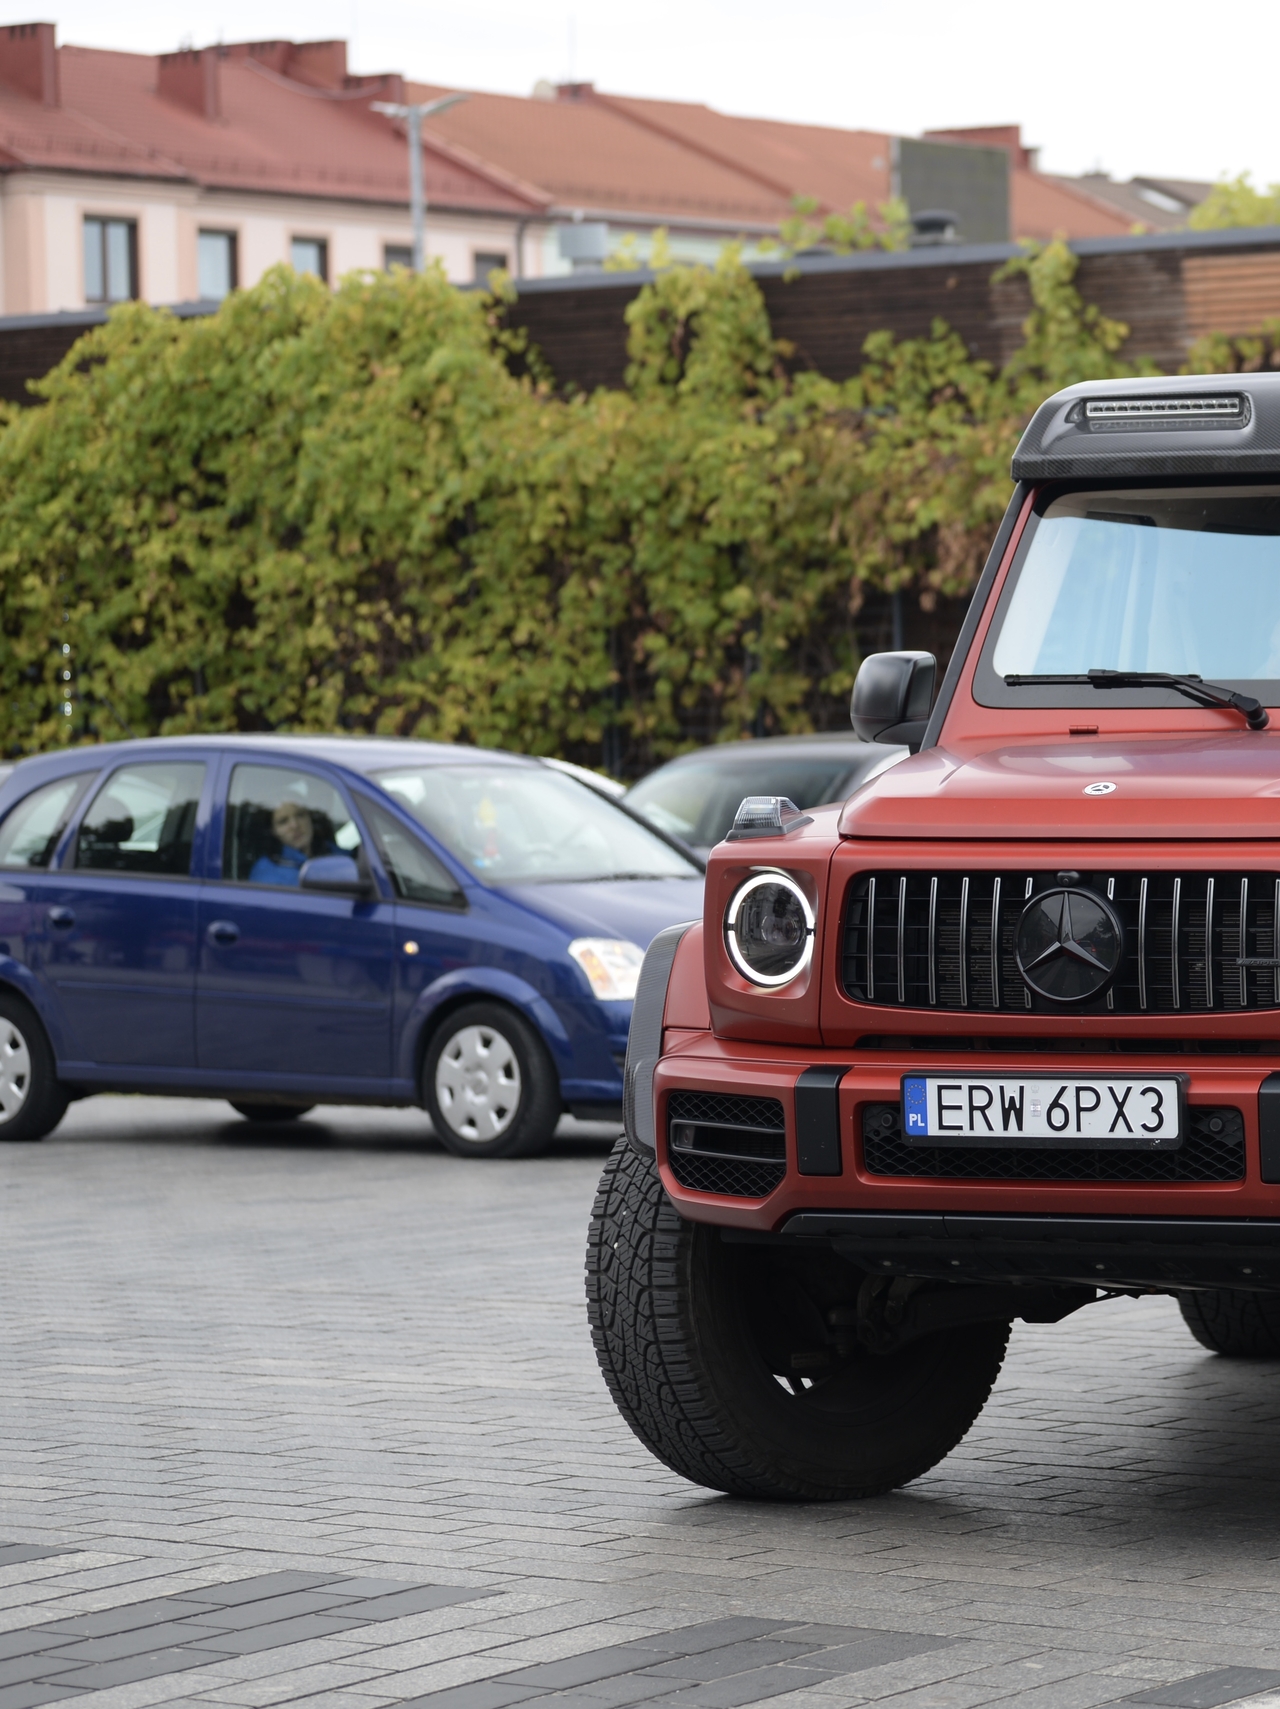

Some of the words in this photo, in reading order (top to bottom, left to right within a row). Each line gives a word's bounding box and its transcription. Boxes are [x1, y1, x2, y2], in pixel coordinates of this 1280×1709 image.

[909, 1113, 926, 1127] PL
[936, 1084, 1025, 1132] ERW
[1046, 1085, 1165, 1133] 6PX3
